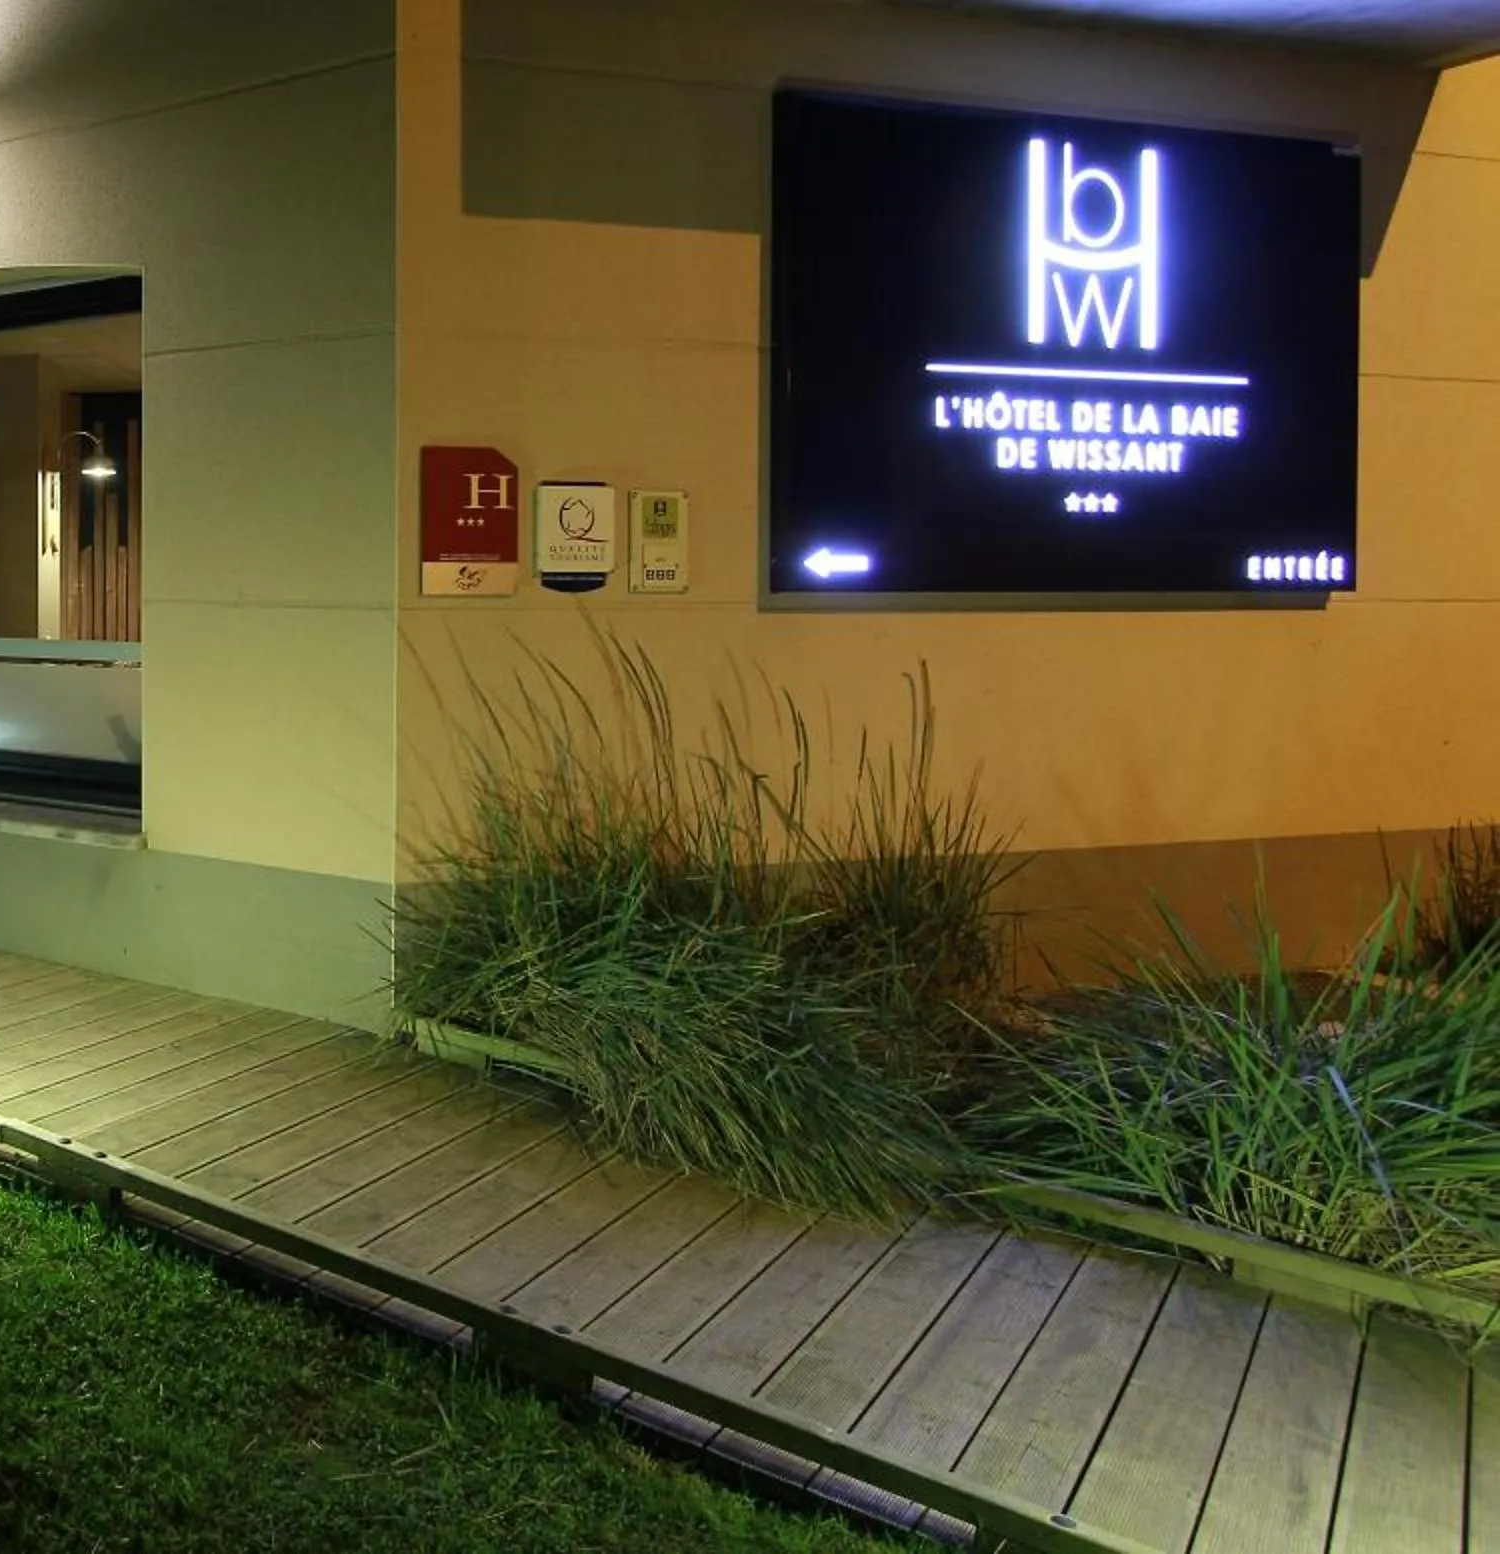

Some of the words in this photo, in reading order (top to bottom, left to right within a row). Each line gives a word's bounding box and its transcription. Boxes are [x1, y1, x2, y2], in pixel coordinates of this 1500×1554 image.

[934, 390, 1061, 432] L'HÔTEL
[1071, 400, 1113, 435] DE
[1121, 402, 1161, 435] LA
[1170, 404, 1239, 438] BAIE
[995, 436, 1038, 470] DE
[1047, 437, 1185, 473] WISSANT
[463, 473, 515, 510] H
[1247, 550, 1343, 581] ENTRÉE
